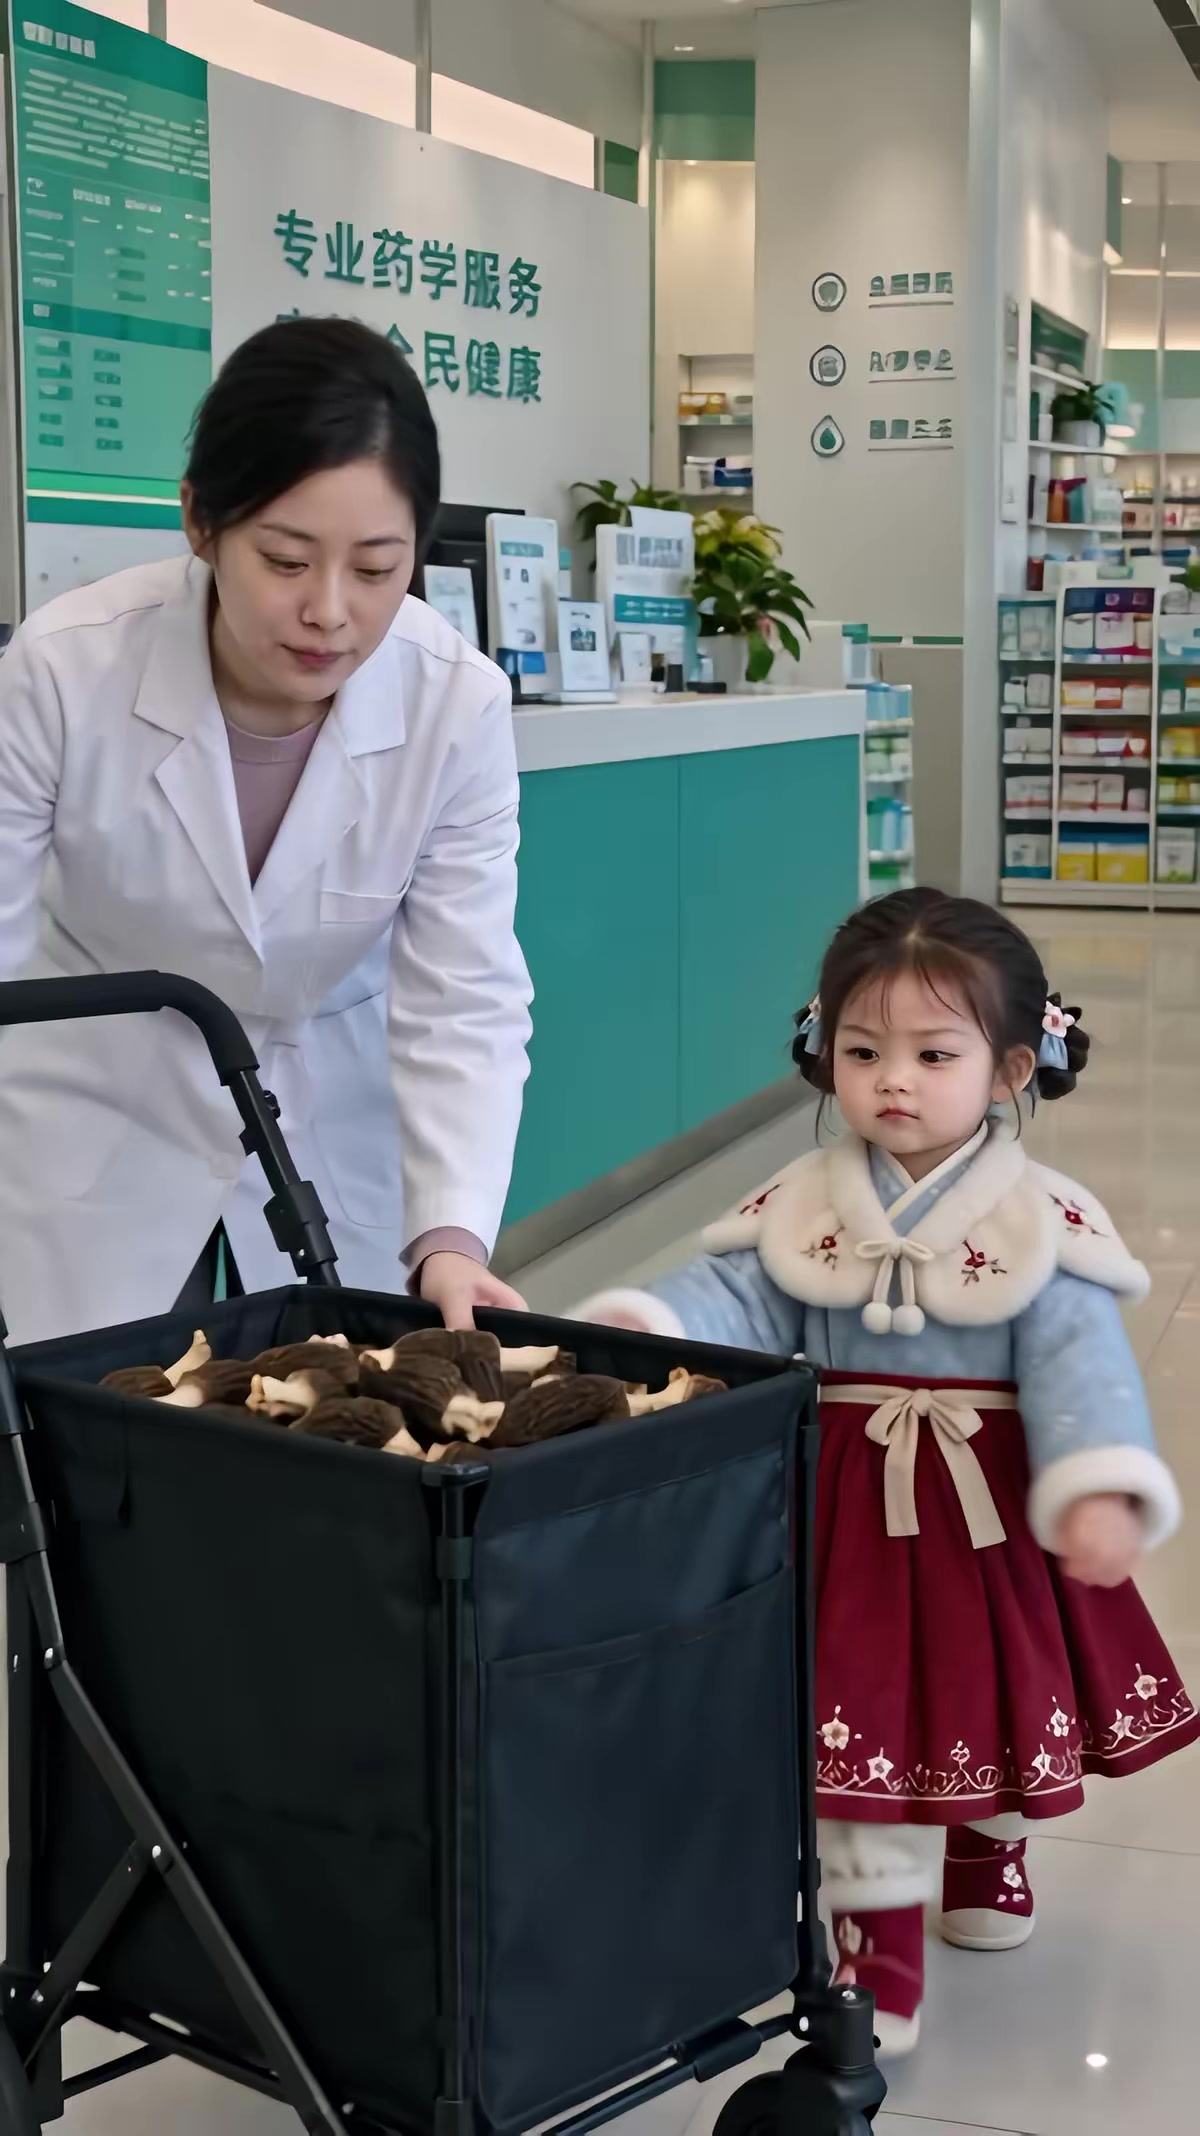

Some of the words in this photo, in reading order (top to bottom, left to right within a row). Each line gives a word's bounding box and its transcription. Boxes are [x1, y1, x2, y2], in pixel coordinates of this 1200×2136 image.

[274, 209, 541, 318] 专业药学服务
